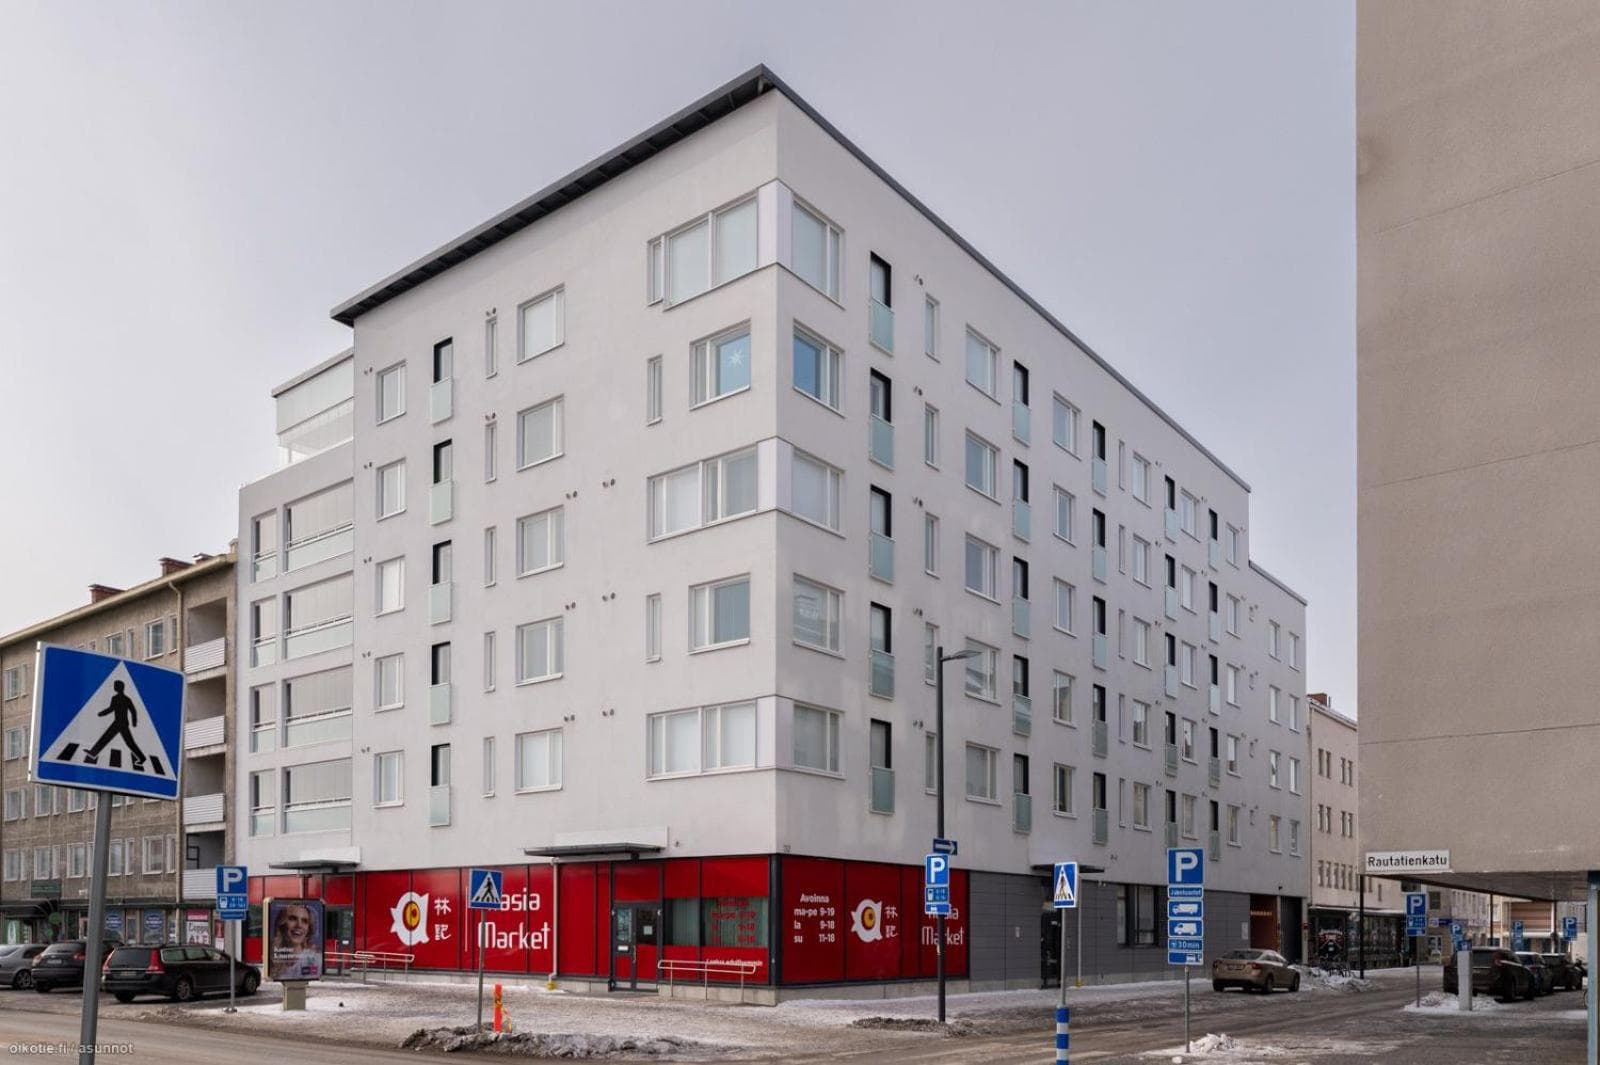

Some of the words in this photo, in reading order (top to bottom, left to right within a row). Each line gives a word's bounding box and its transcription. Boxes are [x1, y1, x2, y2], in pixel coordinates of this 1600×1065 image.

[1175, 851, 1198, 882] P
[1368, 855, 1447, 867] Rautatienkatu
[930, 857, 946, 883] P
[223, 868, 243, 892] P
[800, 893, 830, 903] Avoinna
[1410, 896, 1423, 914] P
[794, 908, 817, 918] ma-pe
[819, 907, 835, 916] 9-19
[794, 920, 801, 929] la
[820, 920, 835, 929] 9-18
[1566, 918, 1575, 929] P
[478, 922, 551, 949] Market
[794, 935, 803, 943] su
[819, 933, 835, 942] 11-18
[922, 926, 964, 945] Maket
